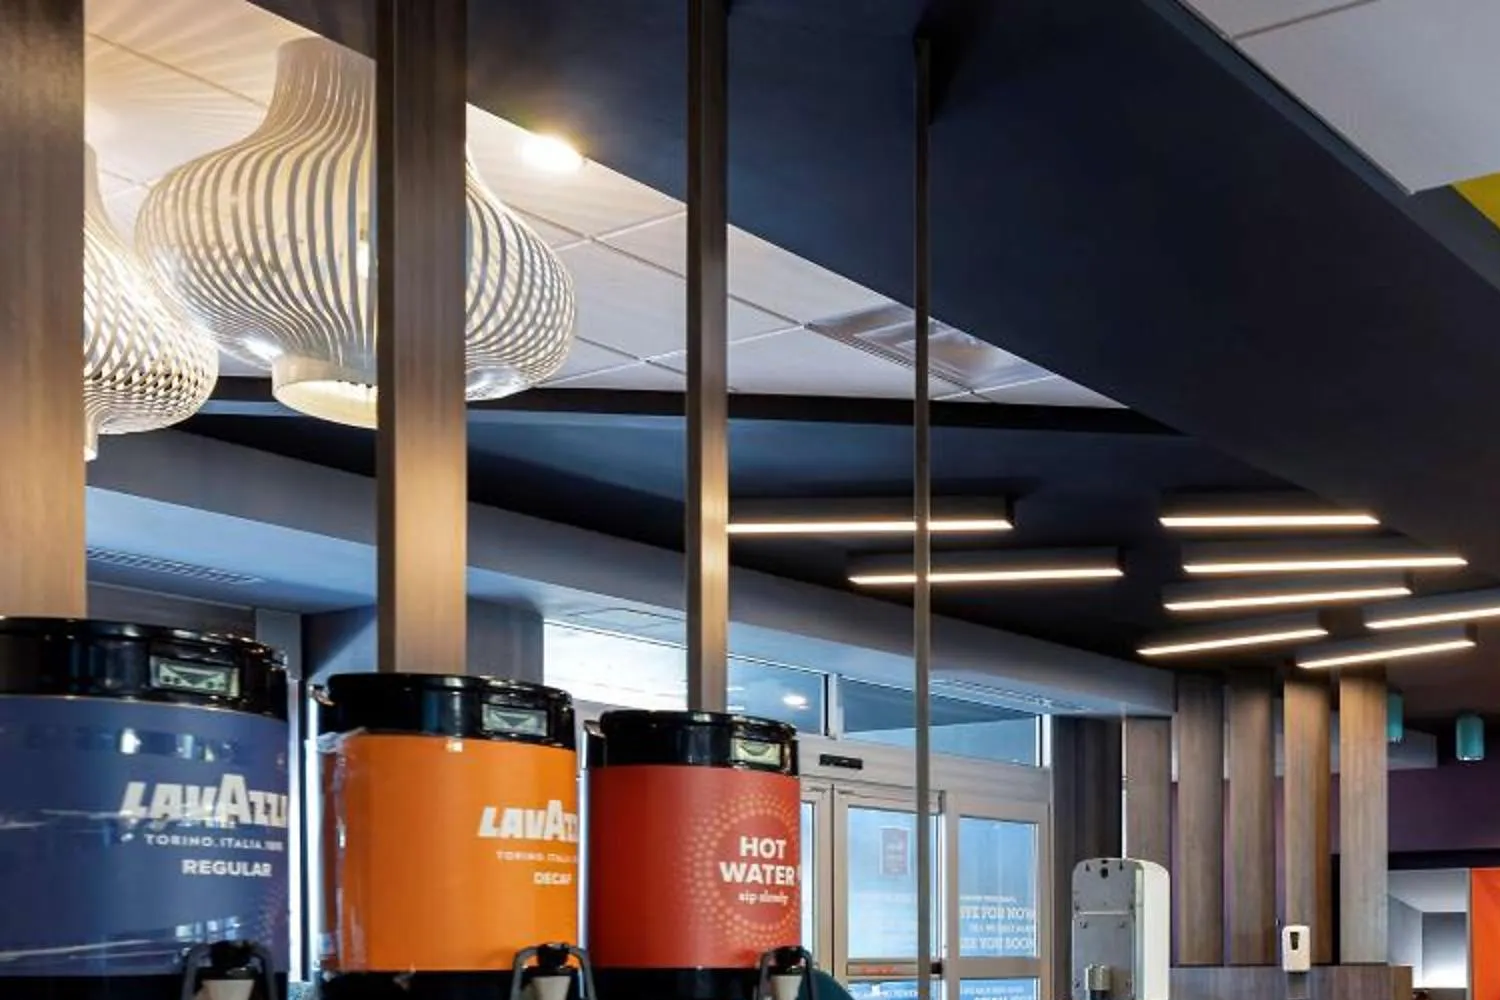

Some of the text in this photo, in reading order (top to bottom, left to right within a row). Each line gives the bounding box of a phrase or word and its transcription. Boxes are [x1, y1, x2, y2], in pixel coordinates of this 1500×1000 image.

[740, 835, 787, 859] HOT
[181, 858, 273, 877] REGULAR
[719, 861, 795, 886] WATER
